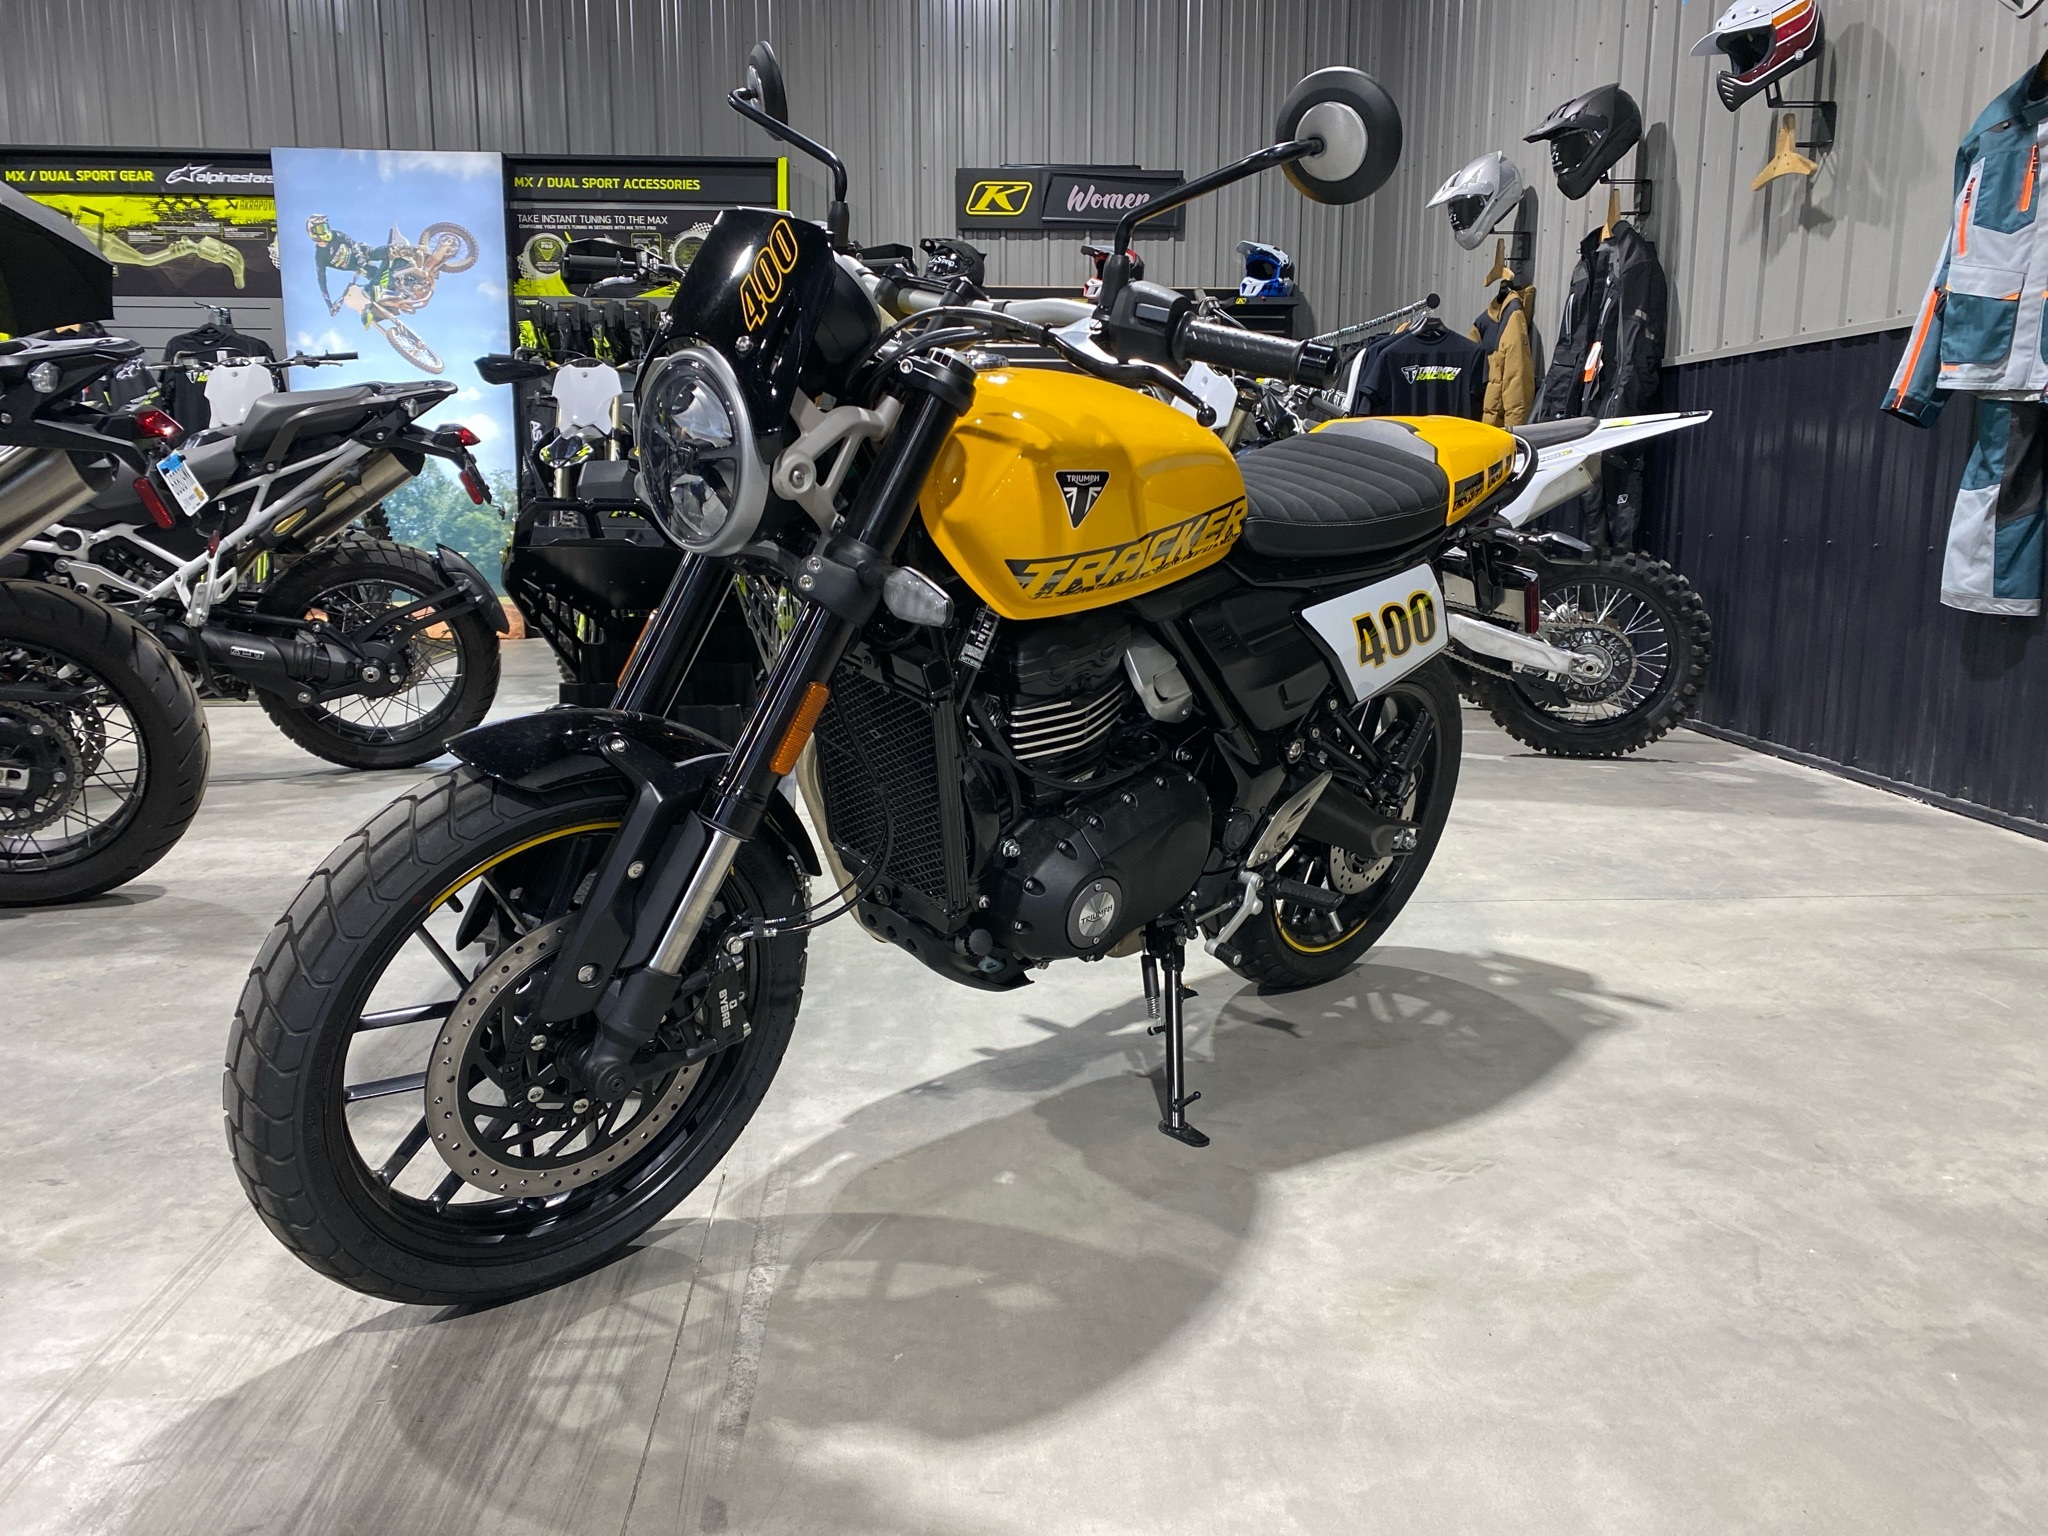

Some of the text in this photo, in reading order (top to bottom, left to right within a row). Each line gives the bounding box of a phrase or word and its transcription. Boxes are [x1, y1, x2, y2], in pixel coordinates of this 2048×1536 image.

[5, 170, 154, 182] MX / DUAL SPORT GEAR
[195, 172, 274, 184] alpinestars
[514, 177, 701, 190] MX / DUAL SPORT ACCESSORIES
[1066, 184, 1151, 212] Women
[517, 214, 668, 225] TAKE INSTANT TUNING TO THE MAX
[739, 218, 798, 331] 400
[1417, 365, 1462, 375] TRIUMPH
[1416, 373, 1457, 381] RACING
[1066, 474, 1100, 486] TRIUMPH
[1022, 502, 1248, 598] TRACKER
[1351, 589, 1437, 669] 400
[1081, 904, 1113, 924] TRIUMPH
[719, 988, 731, 1028] BYBRE
